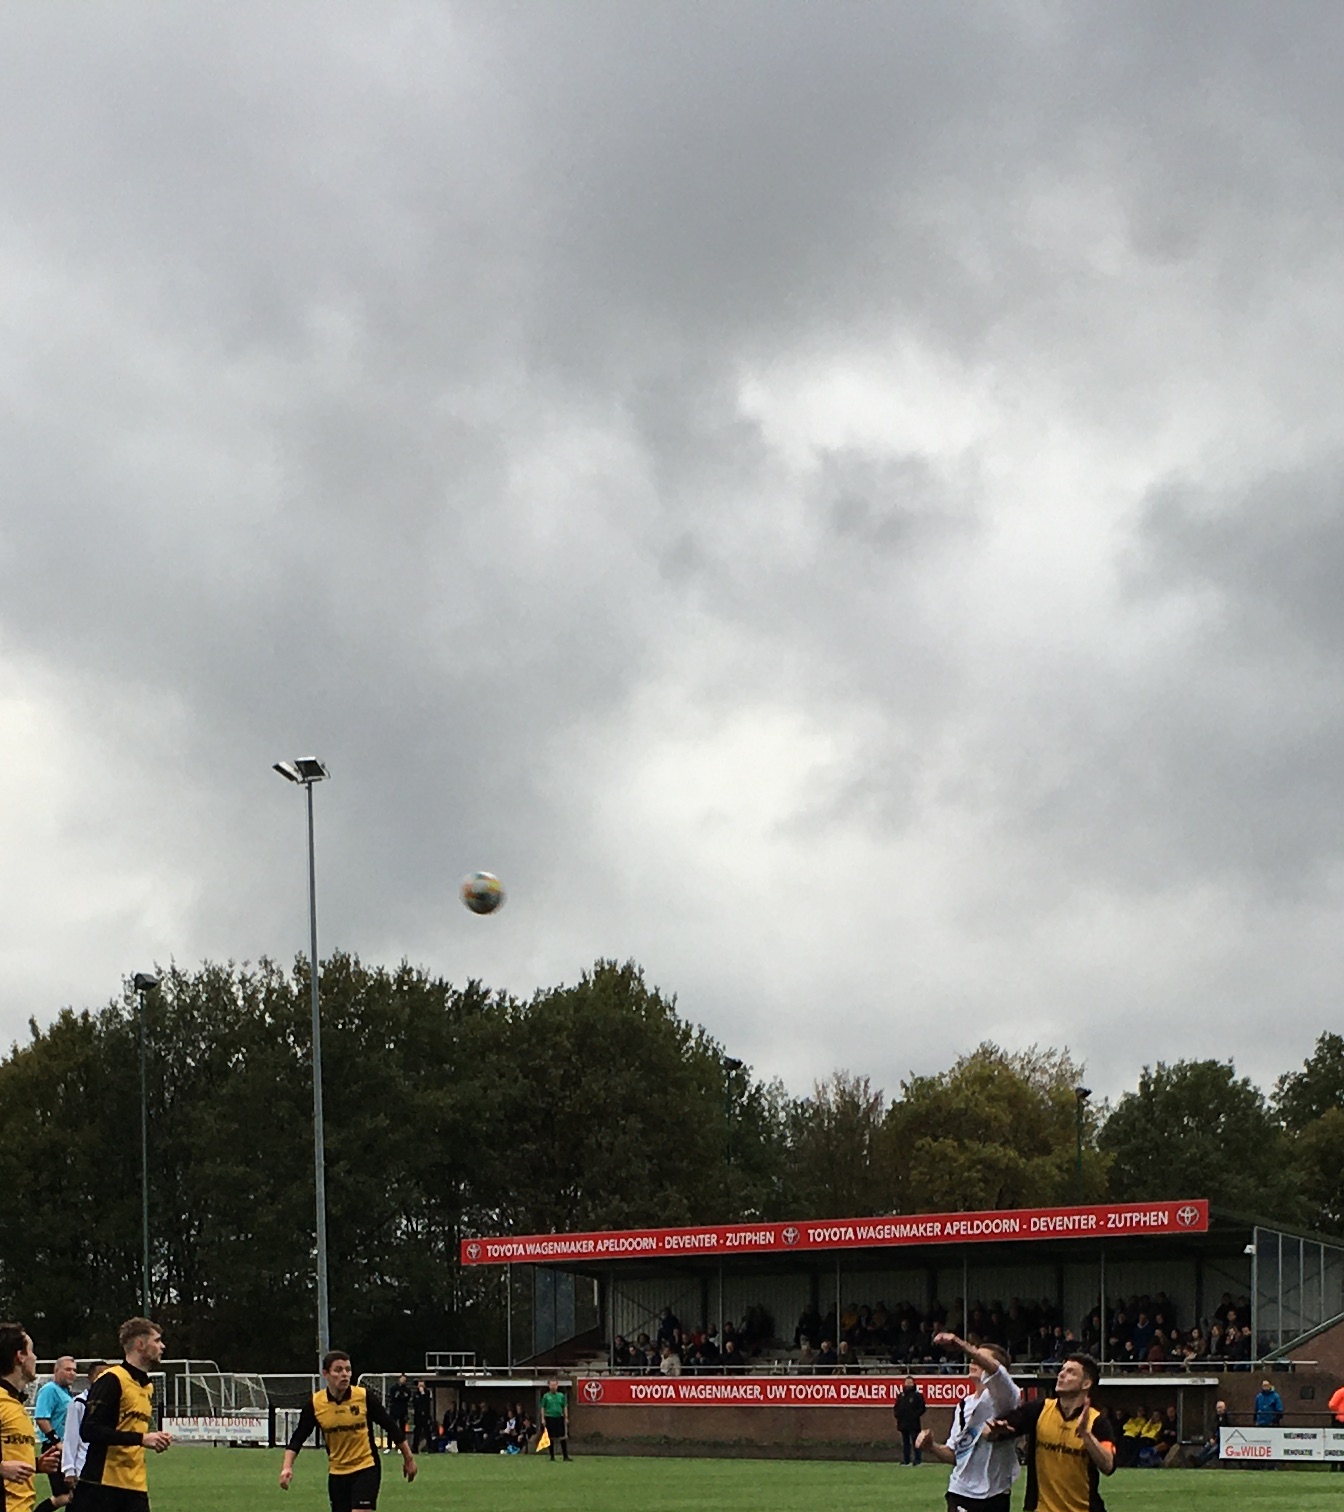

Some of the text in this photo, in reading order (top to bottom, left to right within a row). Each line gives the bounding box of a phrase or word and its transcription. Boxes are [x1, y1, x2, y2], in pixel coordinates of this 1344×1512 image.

[808, 1227, 855, 1242] TOYOTA
[857, 1221, 941, 1240] WAGENMAKER
[944, 1219, 1020, 1236] APELDOORN
[1030, 1215, 1097, 1232] DEVENTER
[1107, 1211, 1169, 1228] ZUTPHEN
[487, 1243, 525, 1257] TOYOTA
[526, 1240, 594, 1256] WAGENMAKER
[596, 1237, 657, 1252] APELDOORN
[665, 1234, 718, 1249] DEVENTER
[726, 1231, 775, 1247] ZUTPHEN
[630, 1384, 676, 1399] TOYOTA
[679, 1384, 764, 1401] WAGENMAKER,
[766, 1384, 787, 1399] UW
[789, 1384, 838, 1399] TOYOTA
[840, 1384, 887, 1399] DEALER
[927, 1384, 970, 1399] REGIO!
[202, 1418, 262, 1428] APELDOORN
